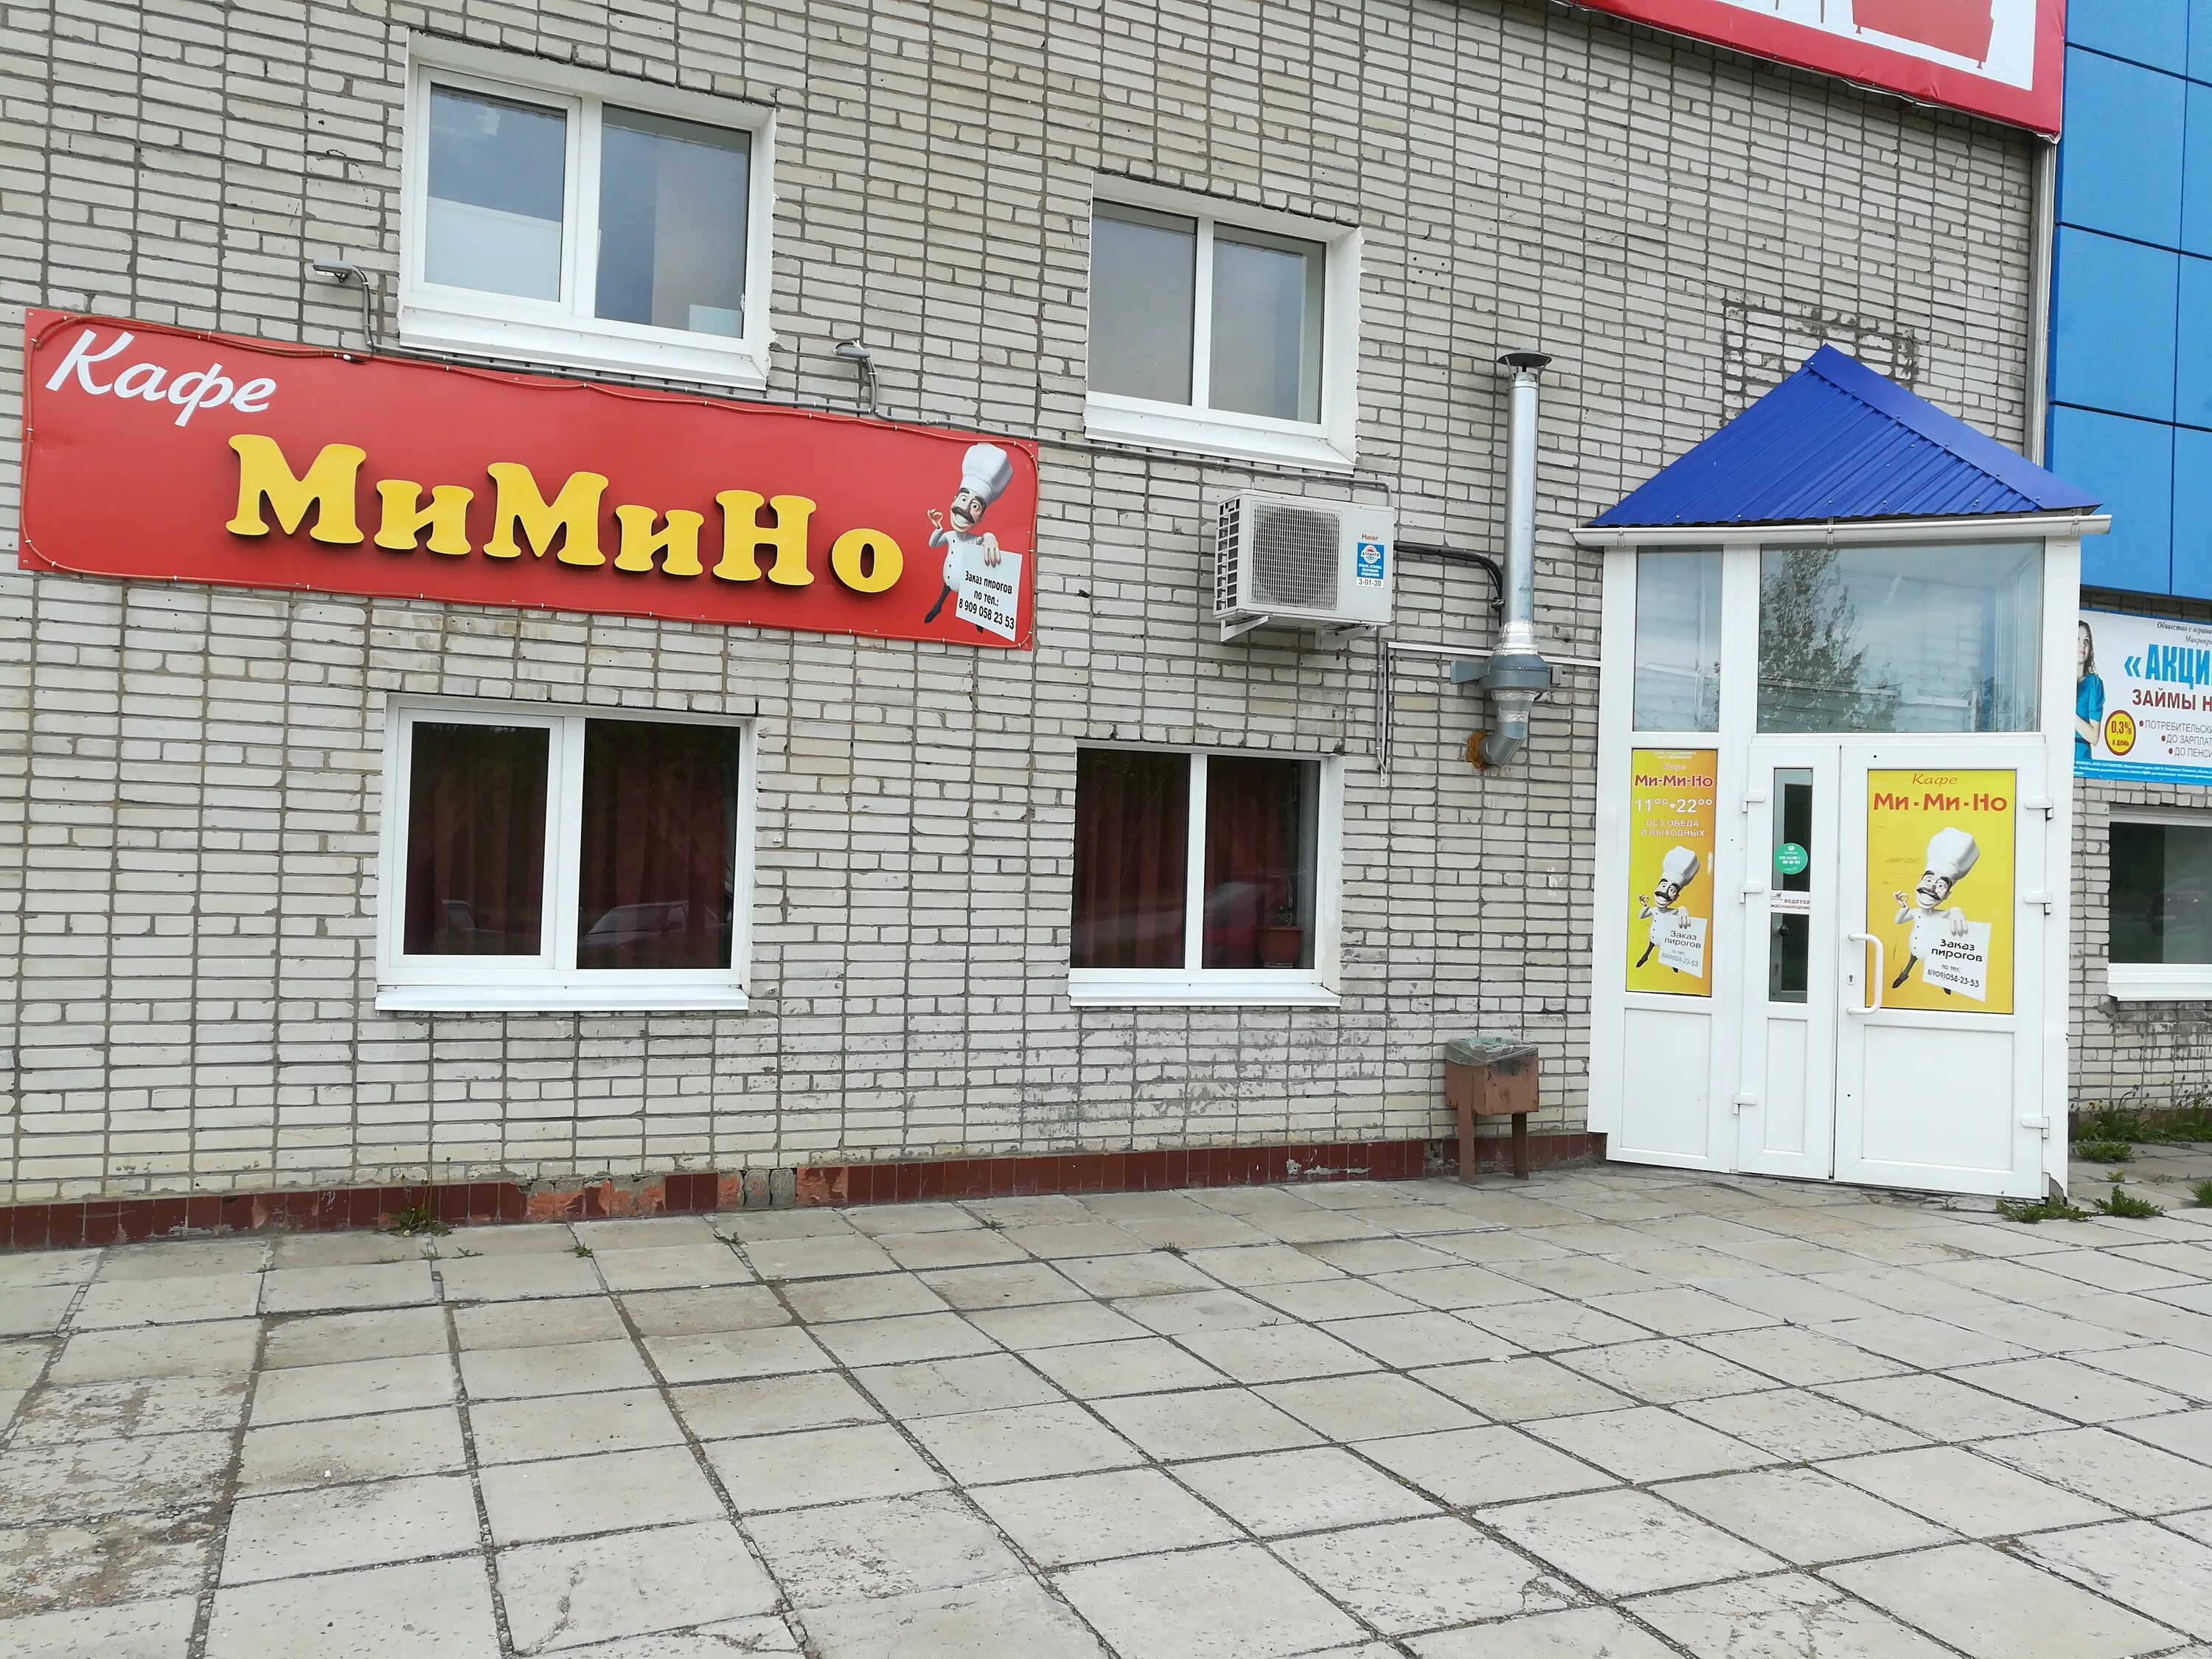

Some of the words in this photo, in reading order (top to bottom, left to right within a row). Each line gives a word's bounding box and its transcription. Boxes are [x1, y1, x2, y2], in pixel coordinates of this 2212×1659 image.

[45, 329, 276, 427] Кафе
[965, 570, 982, 585] Заказ
[984, 578, 1012, 594] пирогов
[1358, 578, 1381, 587] 3-01-30
[973, 590, 982, 600] по
[959, 598, 964, 608] 8
[964, 600, 978, 614] 909
[978, 605, 992, 620] 058
[993, 611, 1004, 625] 23
[1004, 616, 1015, 630] 53
[2157, 621, 2188, 631] Общество
[2124, 644, 2212, 690] «АКЦИ
[2132, 686, 2197, 711] ЗАЙМЫ
[2111, 720, 2132, 734] 0,3%
[2167, 734, 2178, 744] ДО
[2180, 735, 2212, 746] ЗАРПЛАТ
[2174, 747, 2185, 757] ДО
[1634, 774, 1714, 787] Ми-Ми-Но
[1912, 773, 1958, 787] Кафе
[1667, 819, 1700, 827] ОБЕДА
[1649, 829, 1705, 837] ВЫХОДНЫХ
[1670, 930, 1697, 941] Заказ
[1664, 937, 1701, 949] пирогов
[1940, 939, 1975, 951] Заказ
[1931, 948, 1983, 962] пирогов
